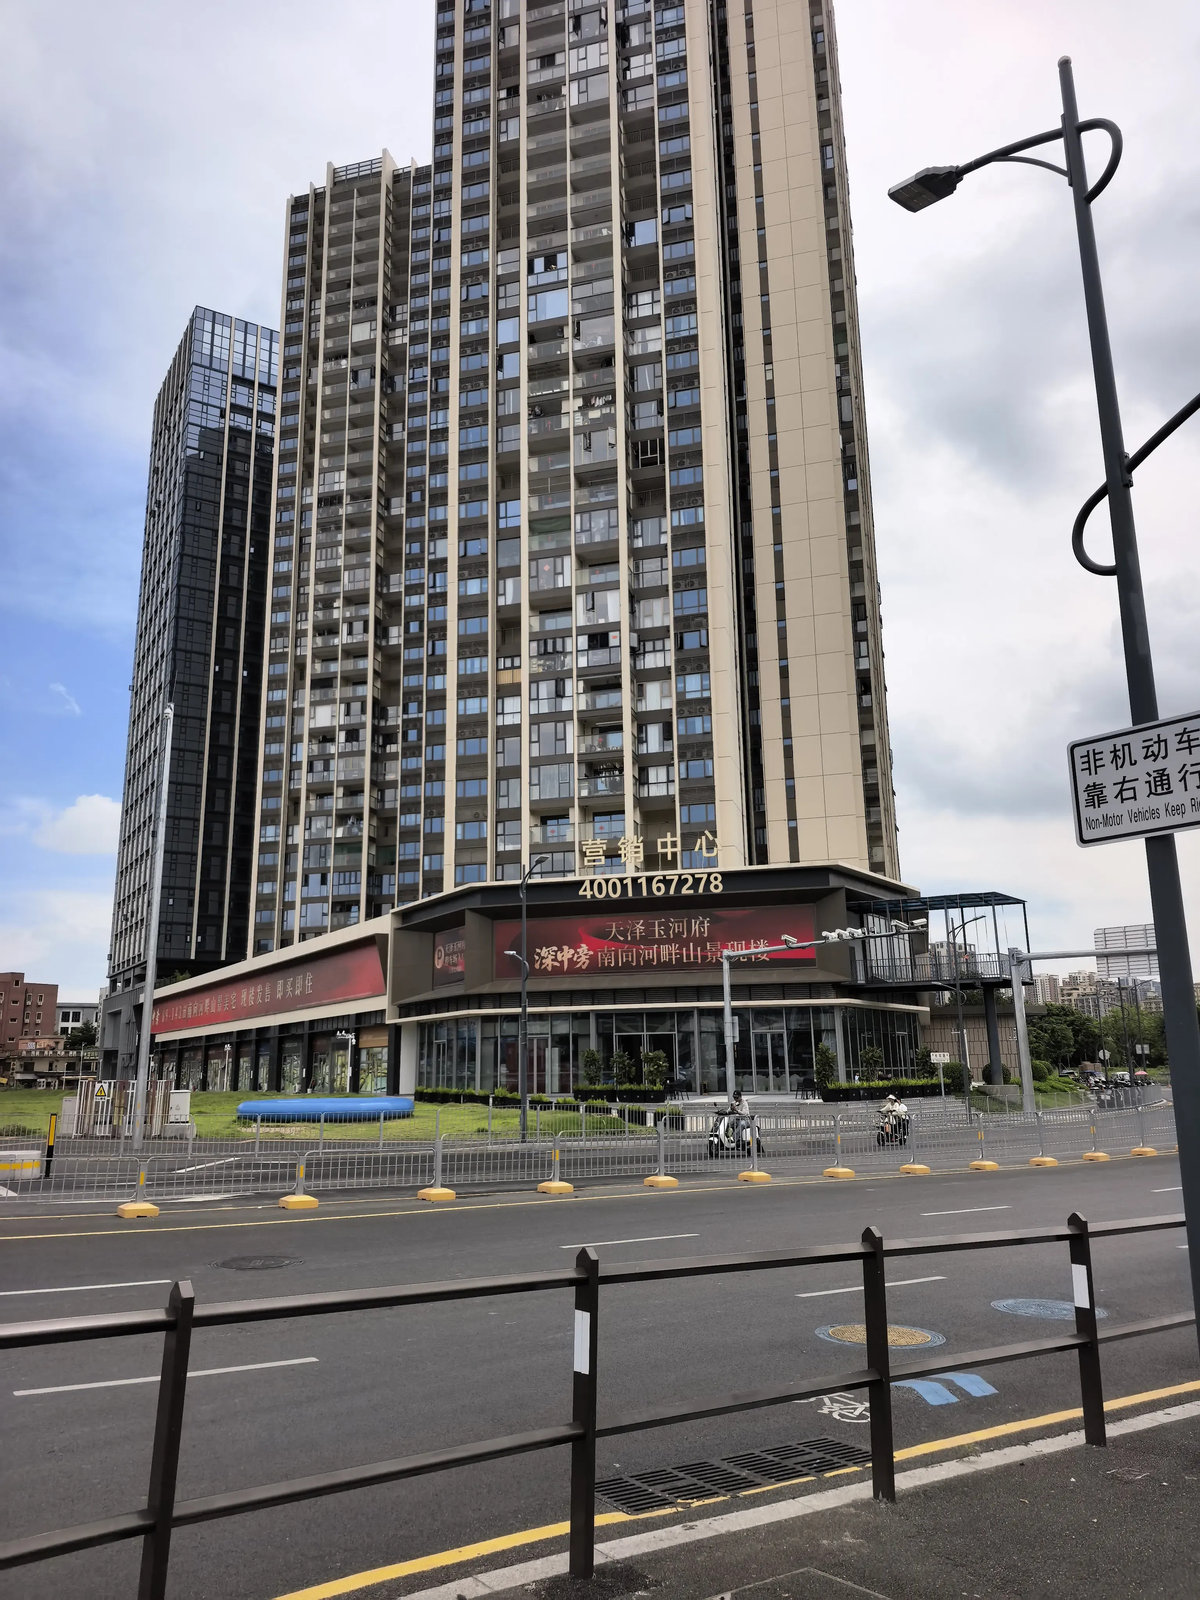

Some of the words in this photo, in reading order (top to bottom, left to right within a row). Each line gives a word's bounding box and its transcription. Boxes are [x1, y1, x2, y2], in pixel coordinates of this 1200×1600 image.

[1080, 727, 1200, 776] 非机动车
[1083, 762, 1200, 810] 靠右通行
[1085, 813, 1124, 831] Non-Motor
[1127, 806, 1161, 823] Vehicles
[1164, 802, 1186, 819] Keep
[581, 829, 721, 866] 营销中心
[578, 872, 724, 899] 4001167278
[605, 916, 710, 941] 天泽玉河府
[276, 972, 313, 999] 即买即住
